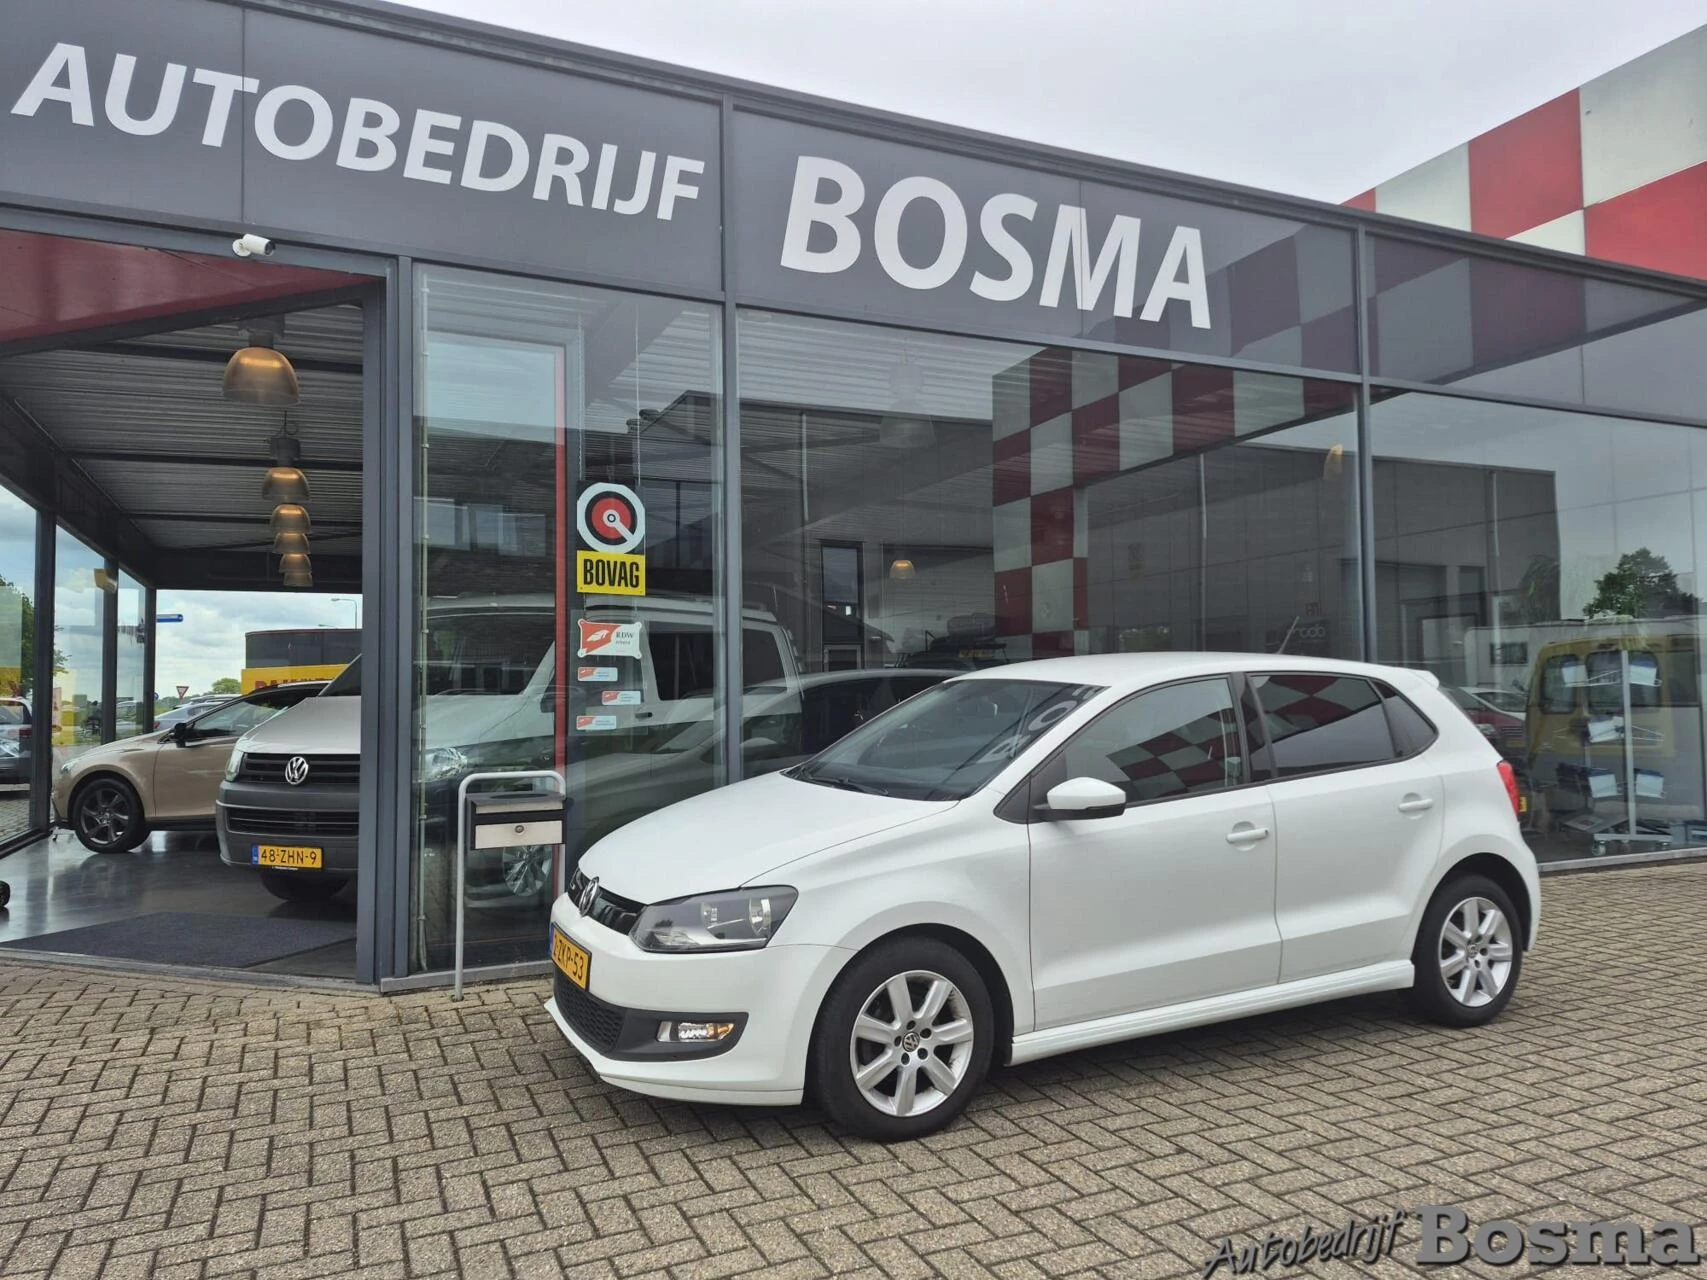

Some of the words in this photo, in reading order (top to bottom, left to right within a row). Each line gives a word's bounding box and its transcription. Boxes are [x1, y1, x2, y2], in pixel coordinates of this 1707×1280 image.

[10, 42, 705, 221] AUTOBEDRIJF
[780, 155, 1211, 329] BOSMA
[583, 558, 640, 589] BOVAG
[261, 849, 317, 865] 48-ZHN-9
